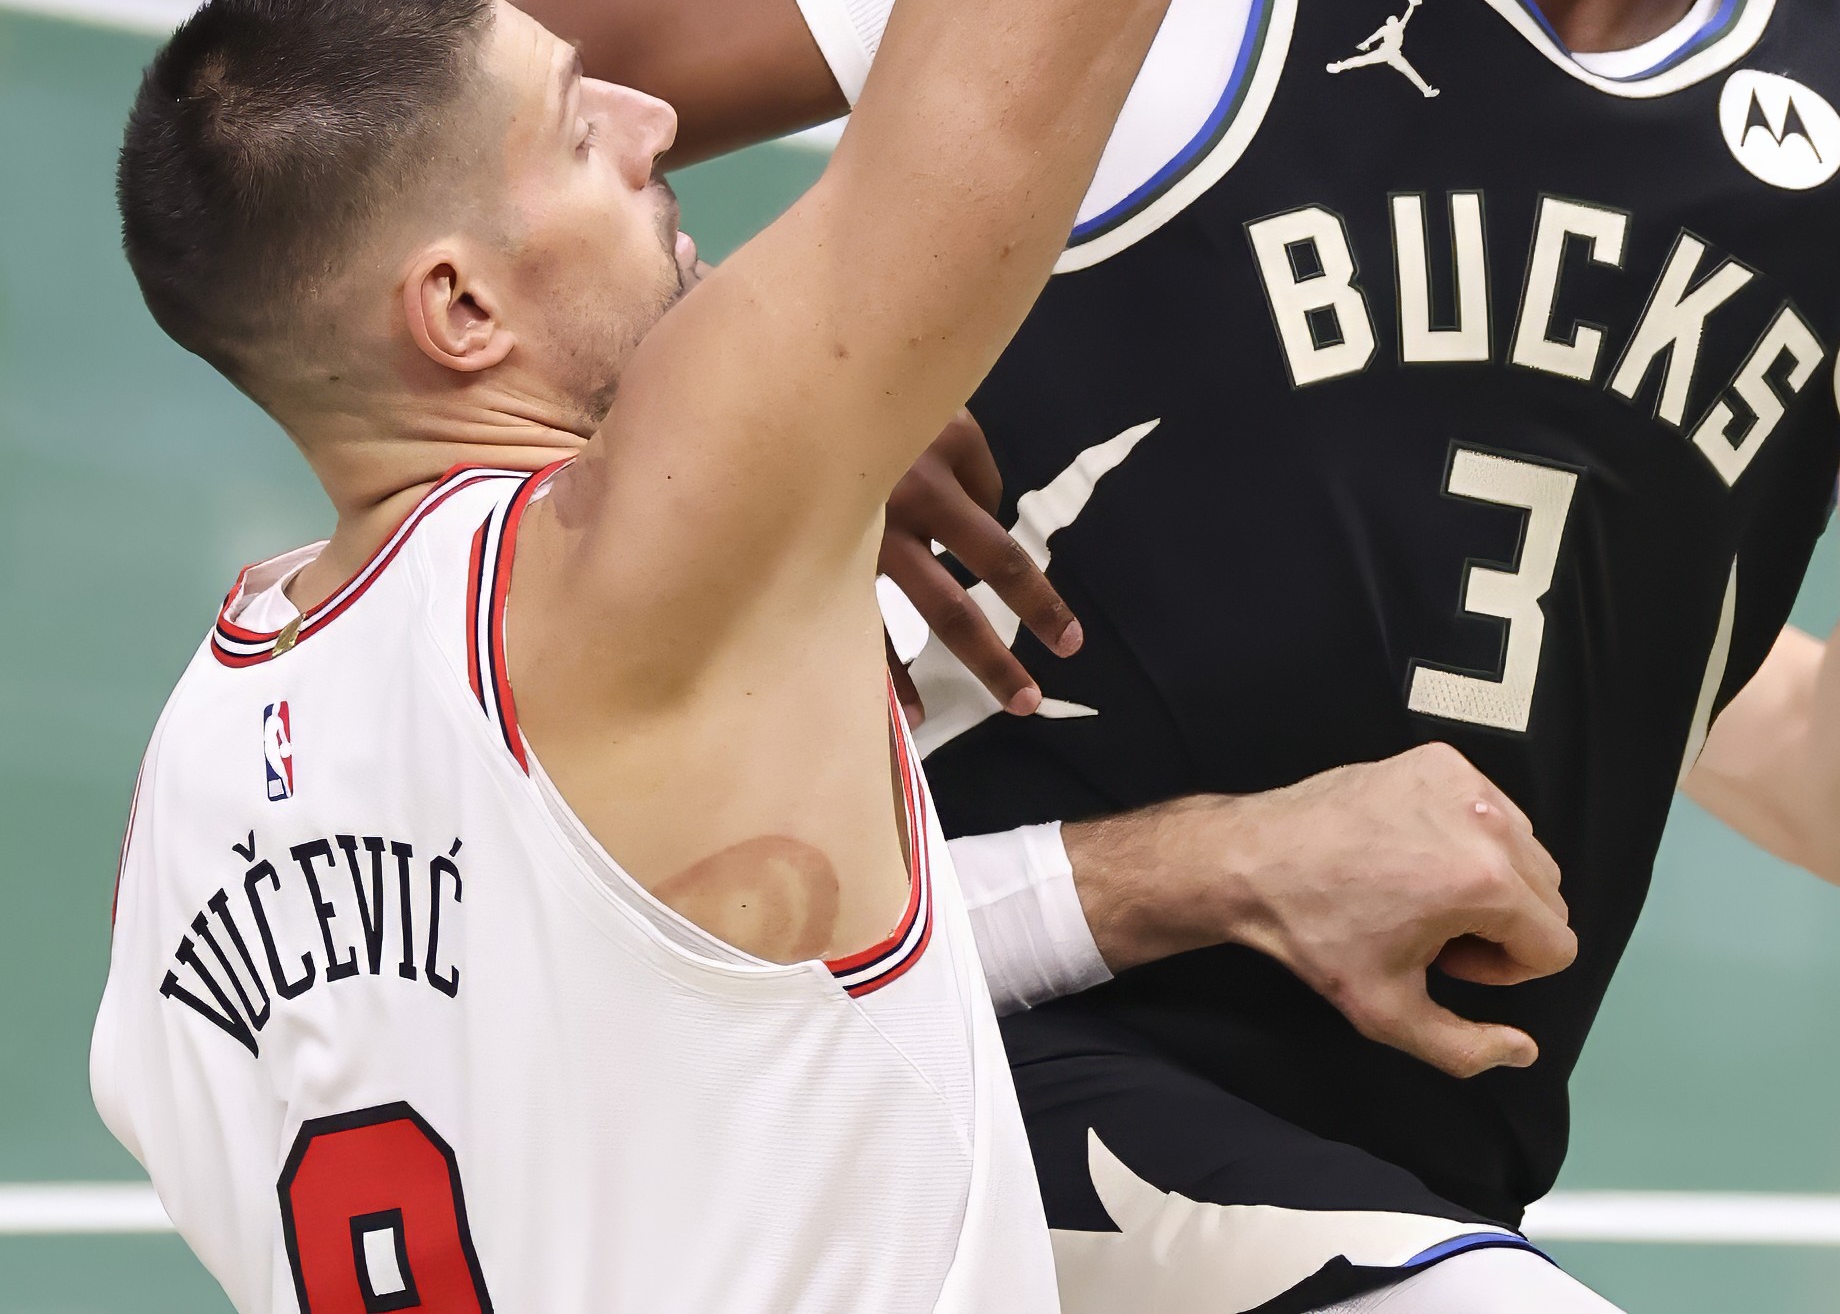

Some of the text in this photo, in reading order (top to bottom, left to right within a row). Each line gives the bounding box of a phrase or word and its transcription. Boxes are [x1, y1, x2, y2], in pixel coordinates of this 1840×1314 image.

[1244, 188, 1827, 487] BUCKS
[1406, 442, 1584, 732] 3
[159, 828, 463, 1059] VUČEVIĆ
